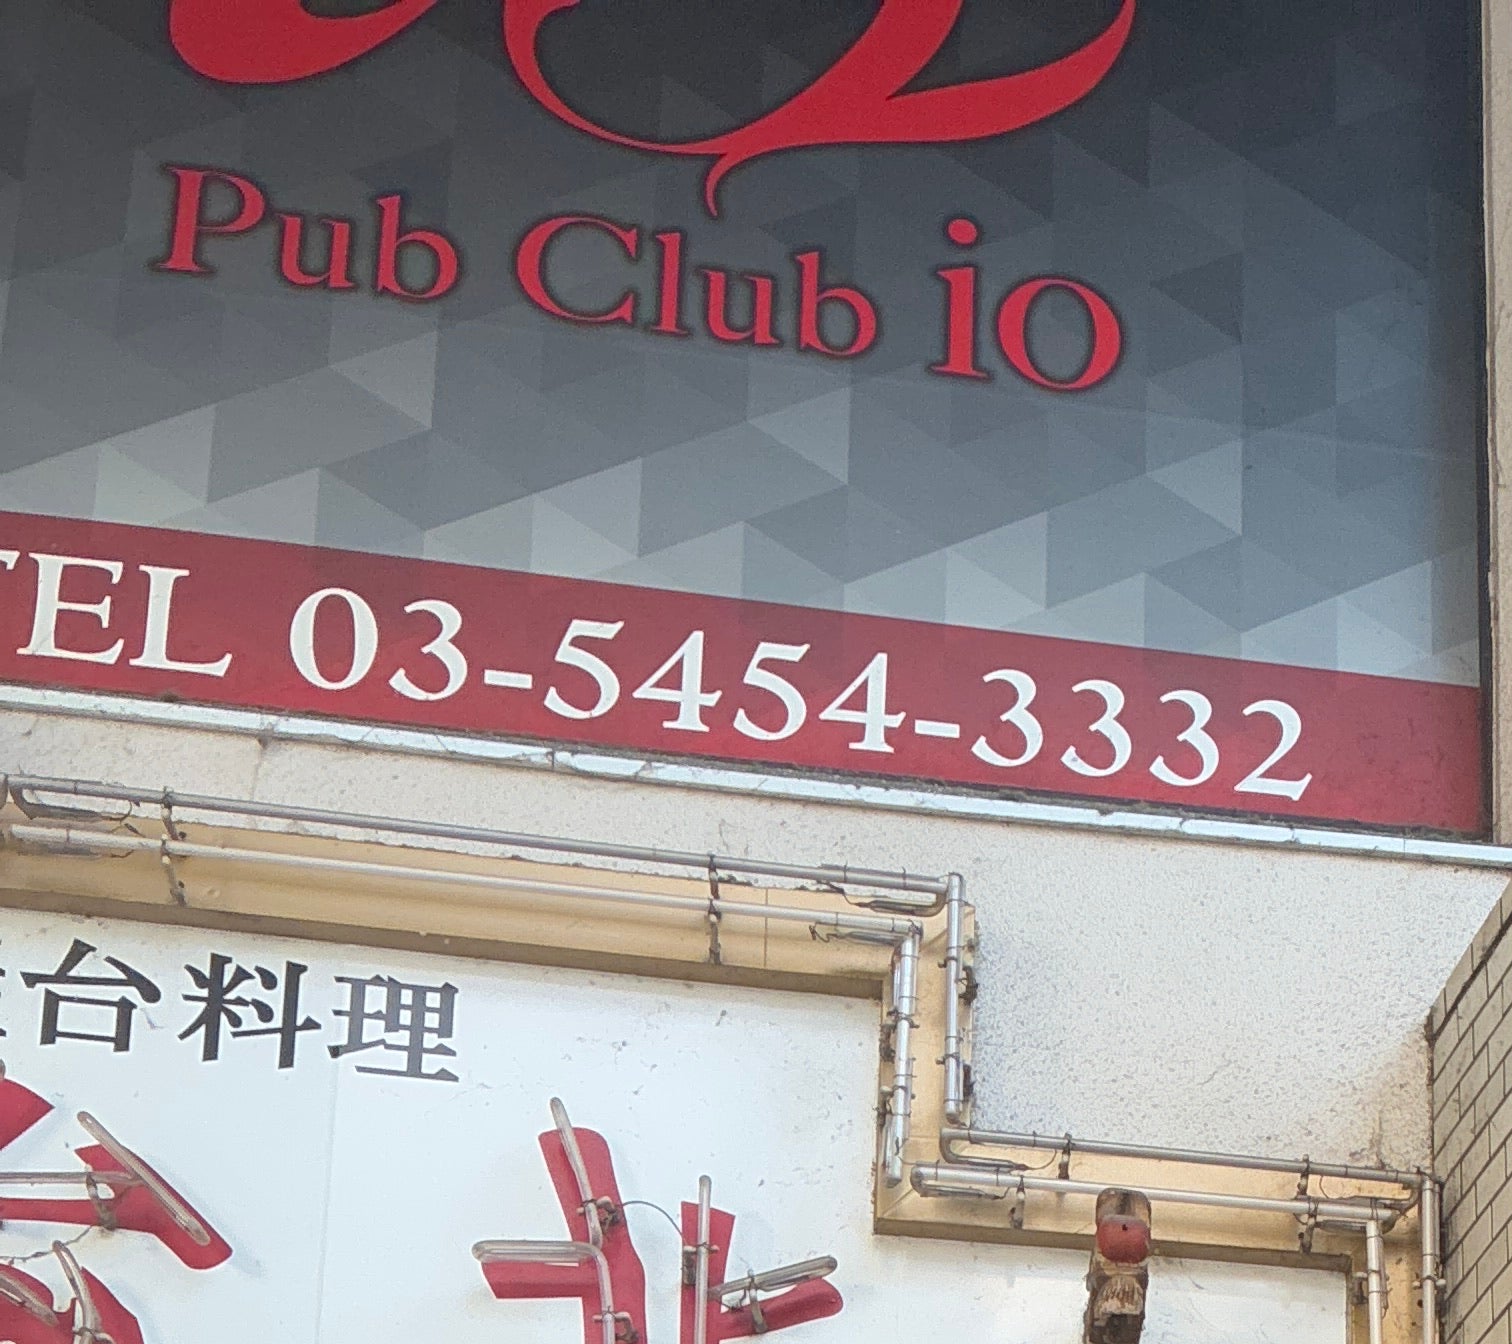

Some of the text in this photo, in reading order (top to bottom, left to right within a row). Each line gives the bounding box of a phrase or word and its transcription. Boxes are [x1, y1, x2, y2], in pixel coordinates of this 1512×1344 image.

[158, 167, 1122, 390] Pub Club io
[0, 549, 1312, 801] EL 03-5454-3332
[0, 938, 459, 1082] 台料理
